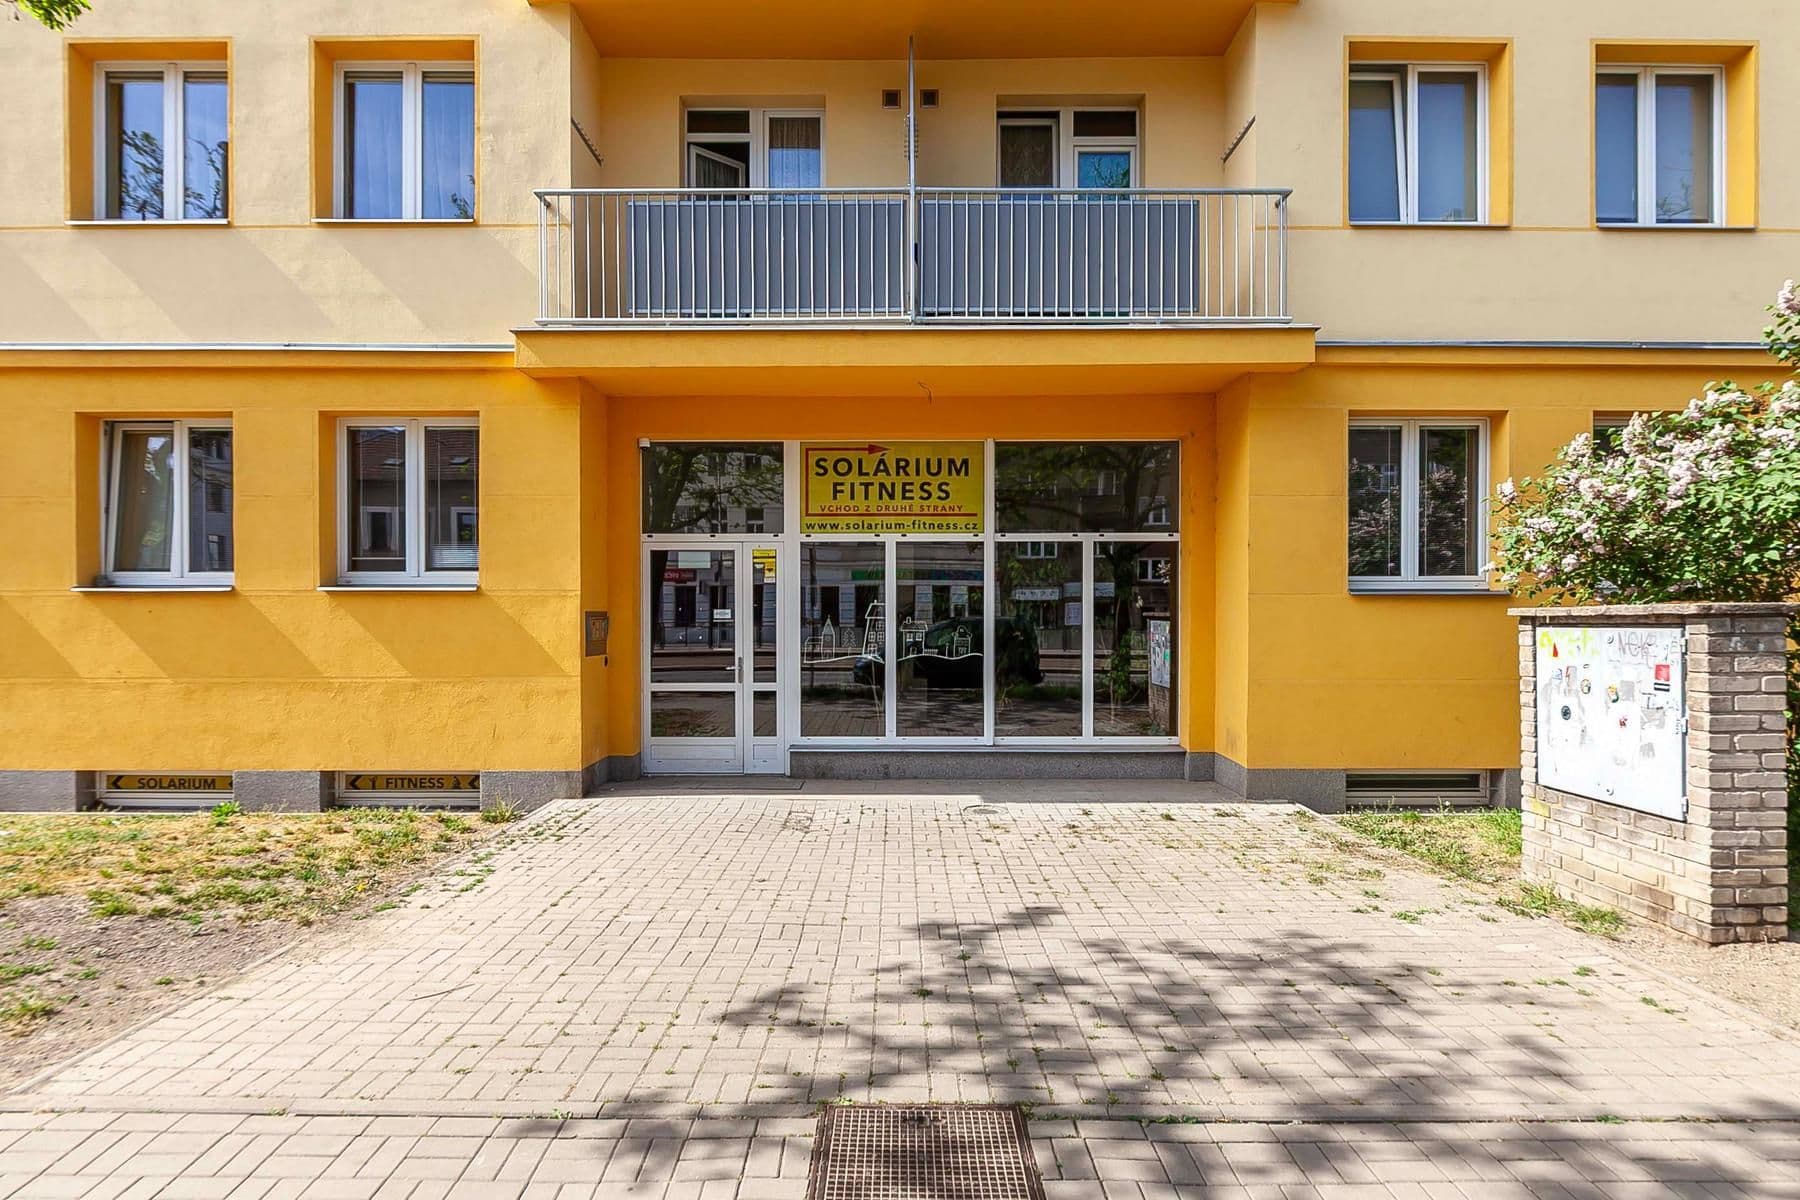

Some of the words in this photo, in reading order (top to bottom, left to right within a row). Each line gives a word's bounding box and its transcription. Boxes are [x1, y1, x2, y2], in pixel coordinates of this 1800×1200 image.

[814, 452, 970, 478] SOLÁRIUM
[832, 481, 951, 501] FITNESS
[819, 504, 860, 513] VCHOD
[864, 504, 871, 513] Z
[876, 503, 914, 513] DRUHÉ
[919, 504, 963, 513] STRANY
[805, 519, 979, 531] www.solarium-fitness.cz
[137, 777, 217, 790] SOLARIUM
[385, 777, 445, 789] FITNESS
